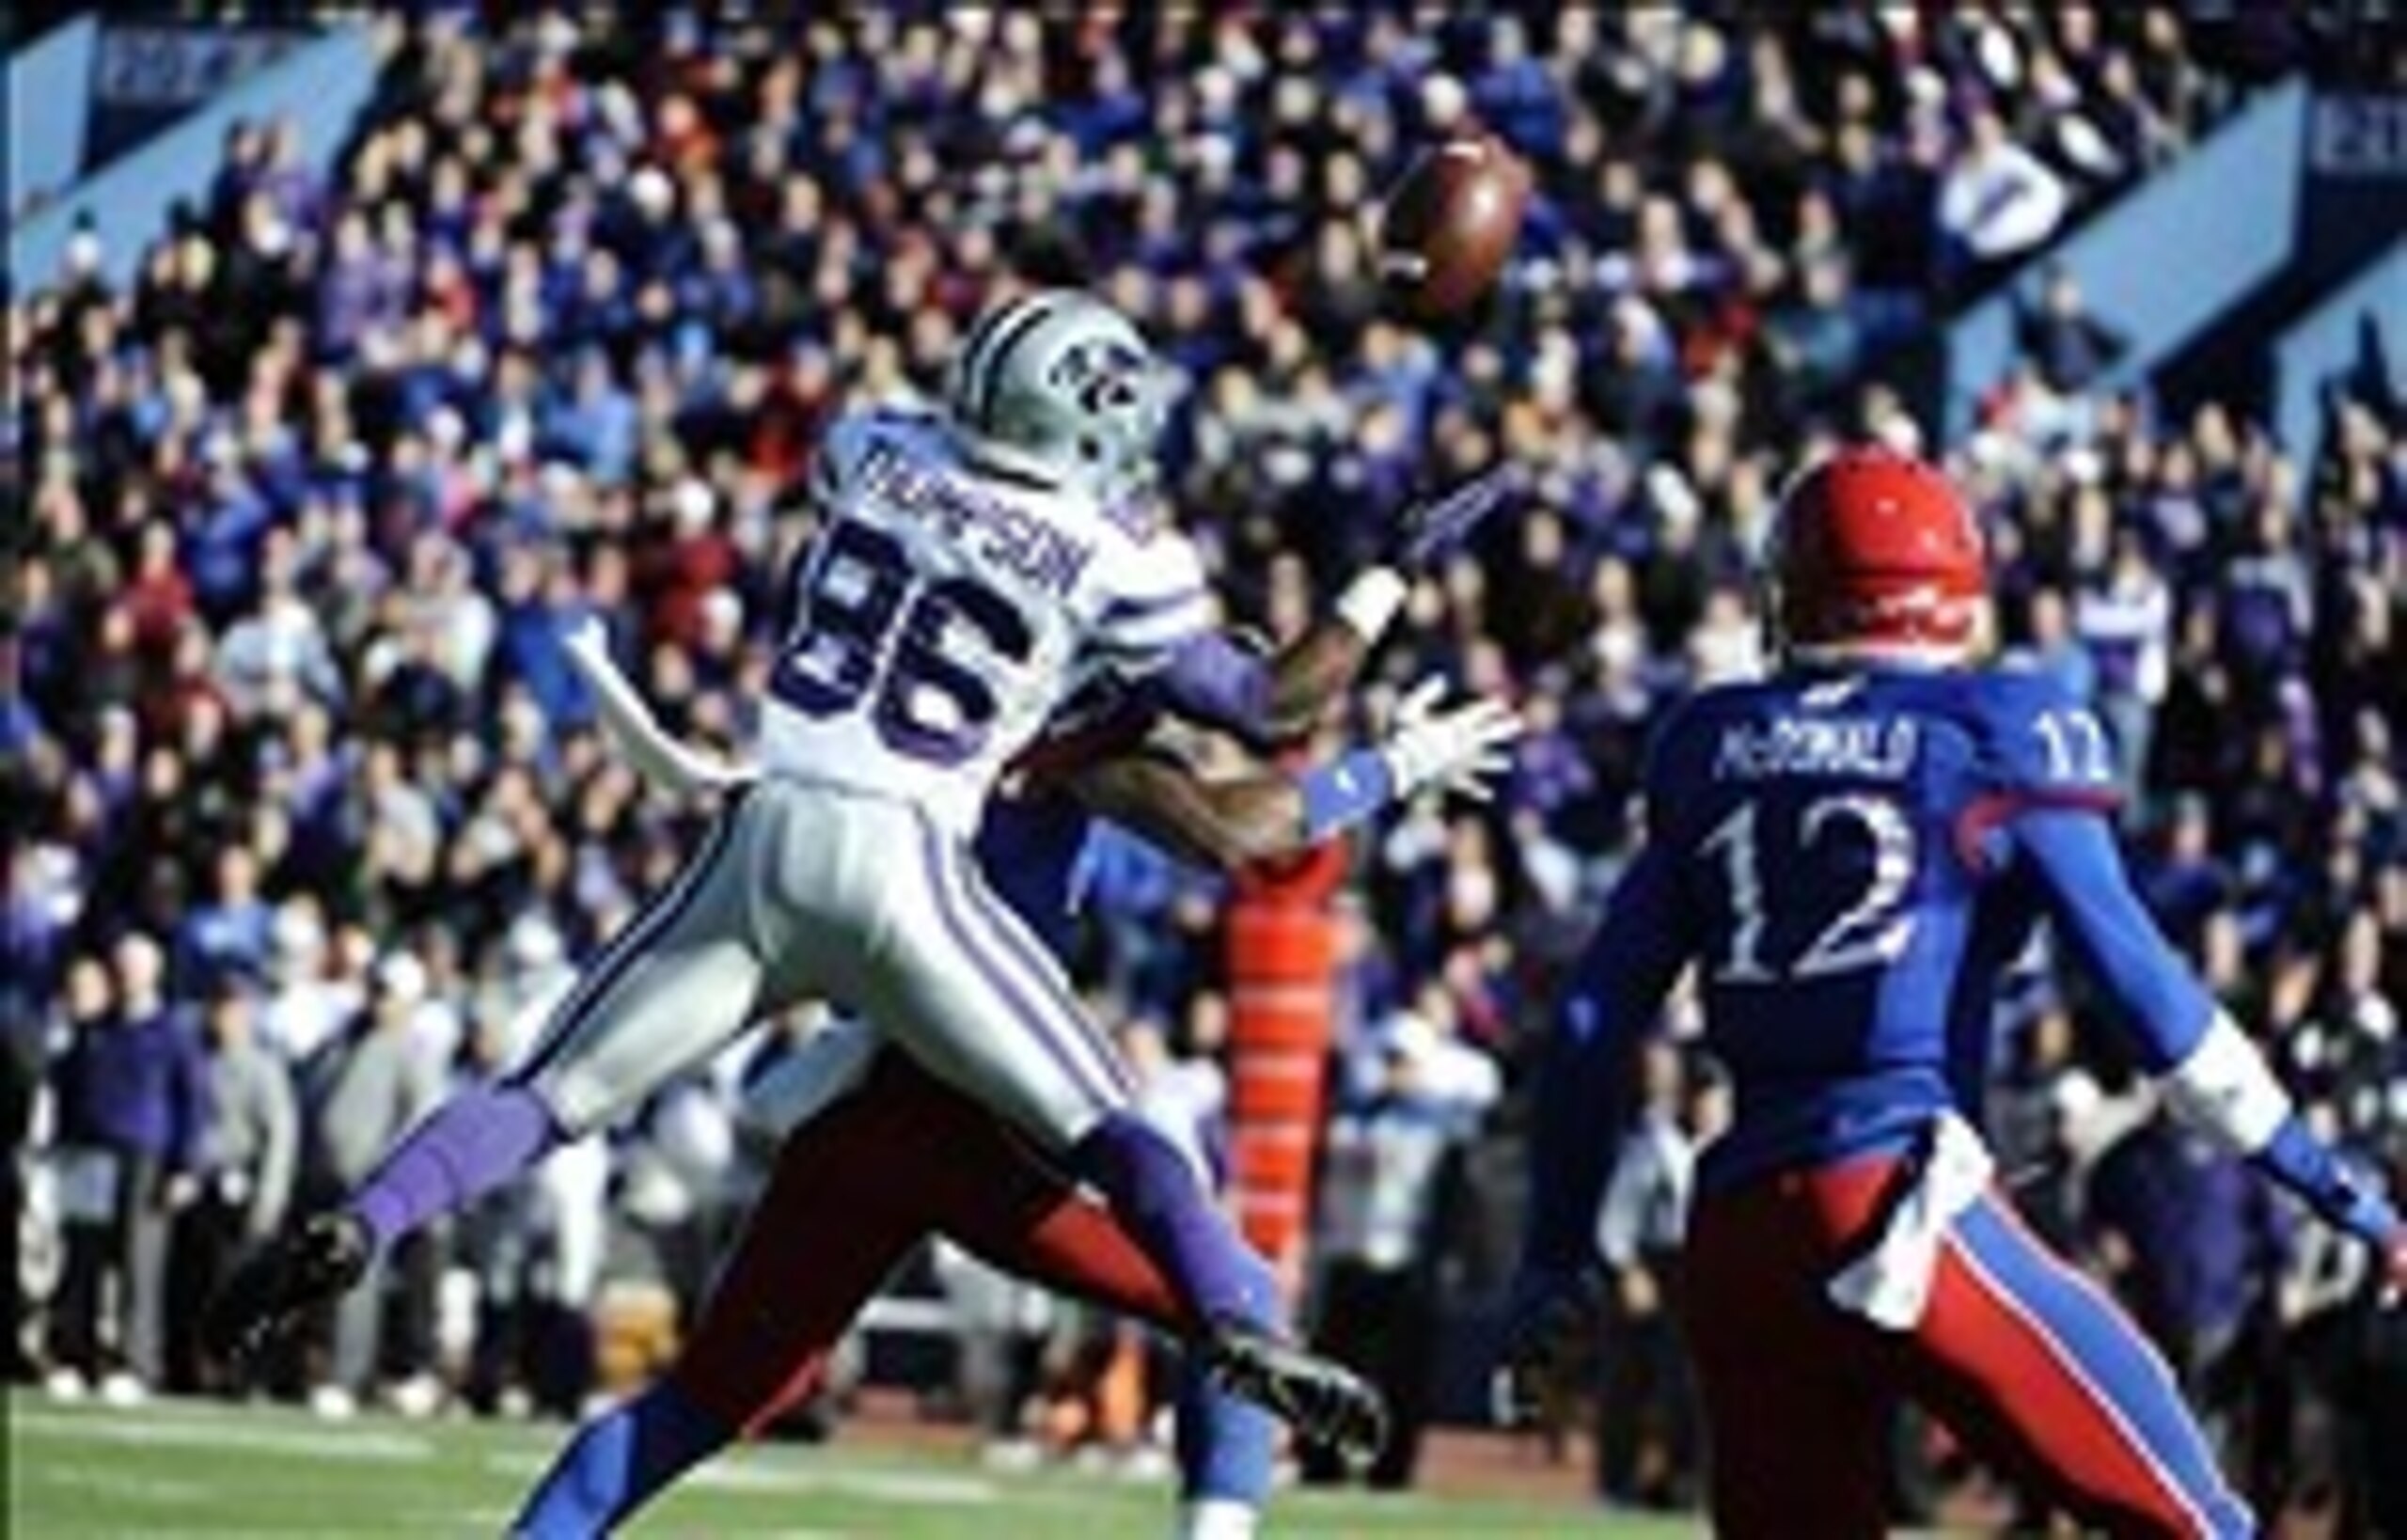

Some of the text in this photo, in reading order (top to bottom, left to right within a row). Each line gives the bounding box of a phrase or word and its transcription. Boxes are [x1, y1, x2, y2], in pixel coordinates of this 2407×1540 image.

[768, 518, 1033, 768] 86
[2032, 708, 2116, 783] 12
[1696, 792, 1916, 984] 12
